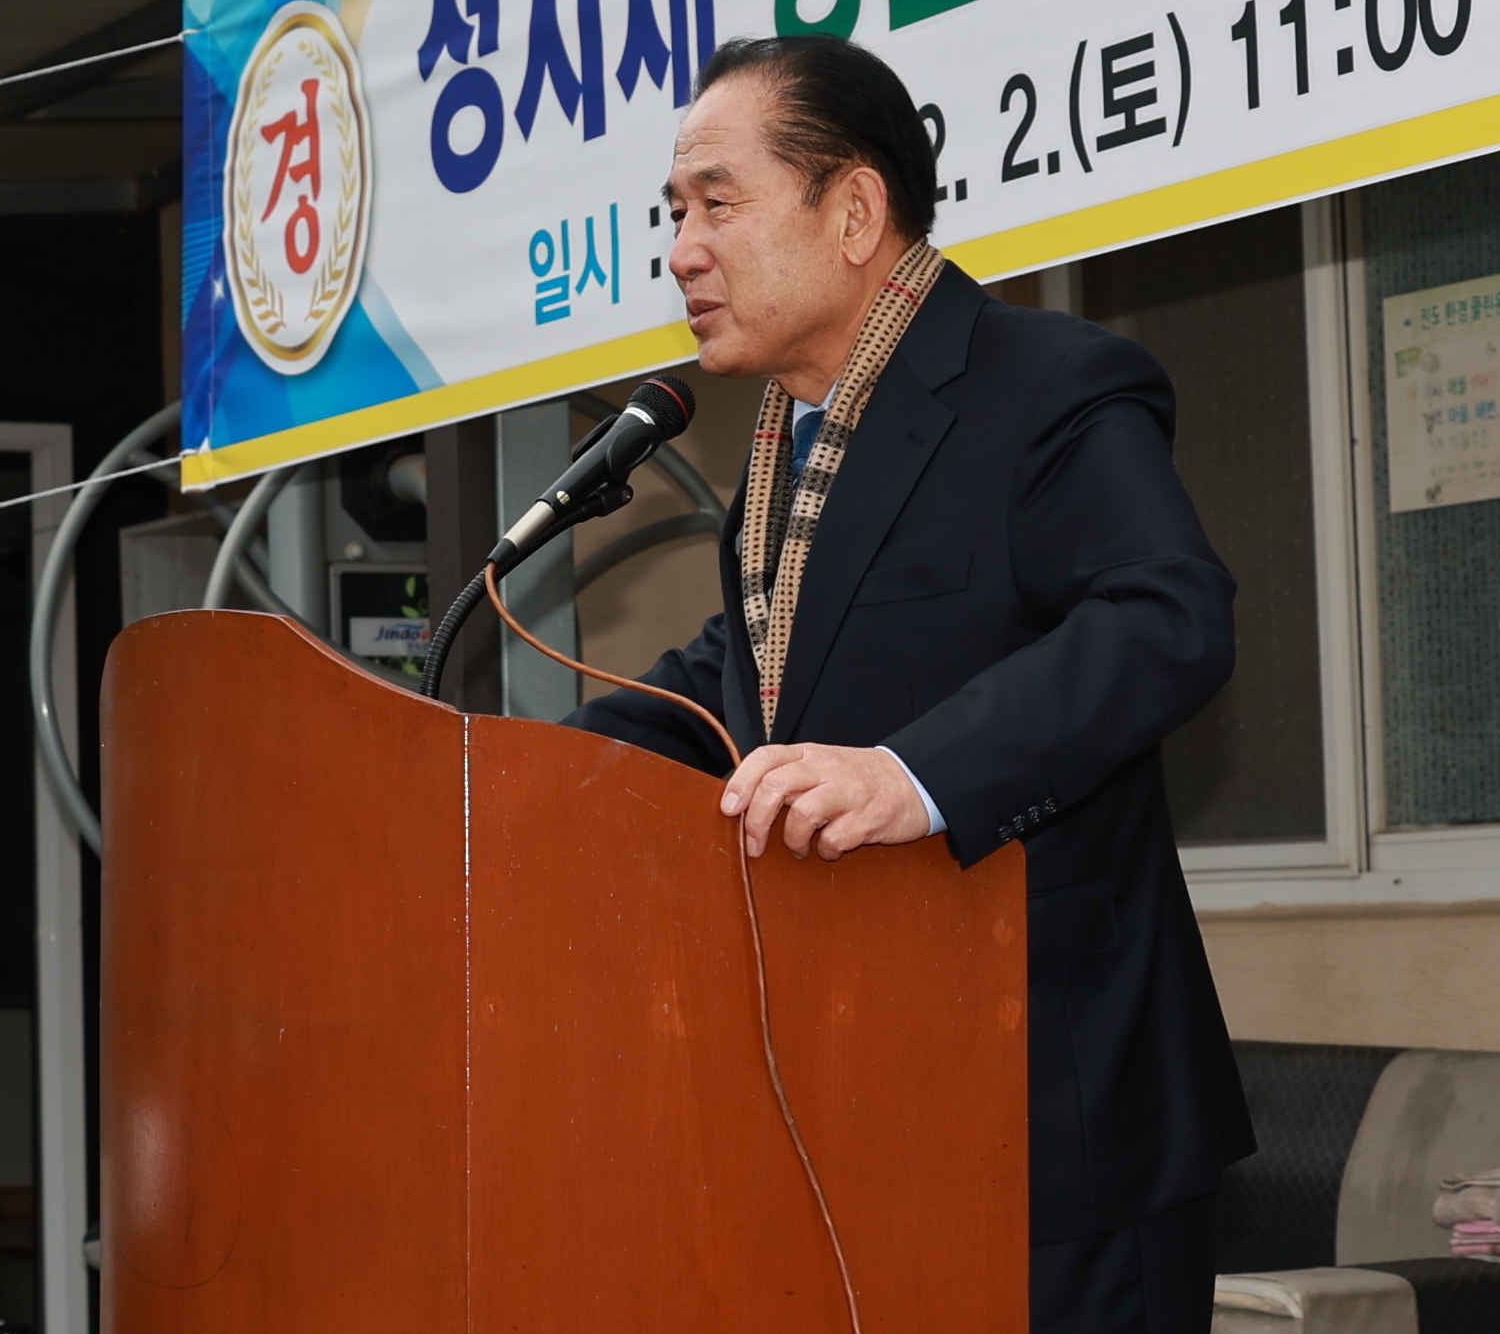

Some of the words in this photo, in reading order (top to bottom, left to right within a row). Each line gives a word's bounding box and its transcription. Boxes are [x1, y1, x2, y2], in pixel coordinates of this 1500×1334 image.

[259, 78, 322, 276] 경
[527, 202, 622, 326] 일시
[1000, 12, 1191, 184] 2.(토)
